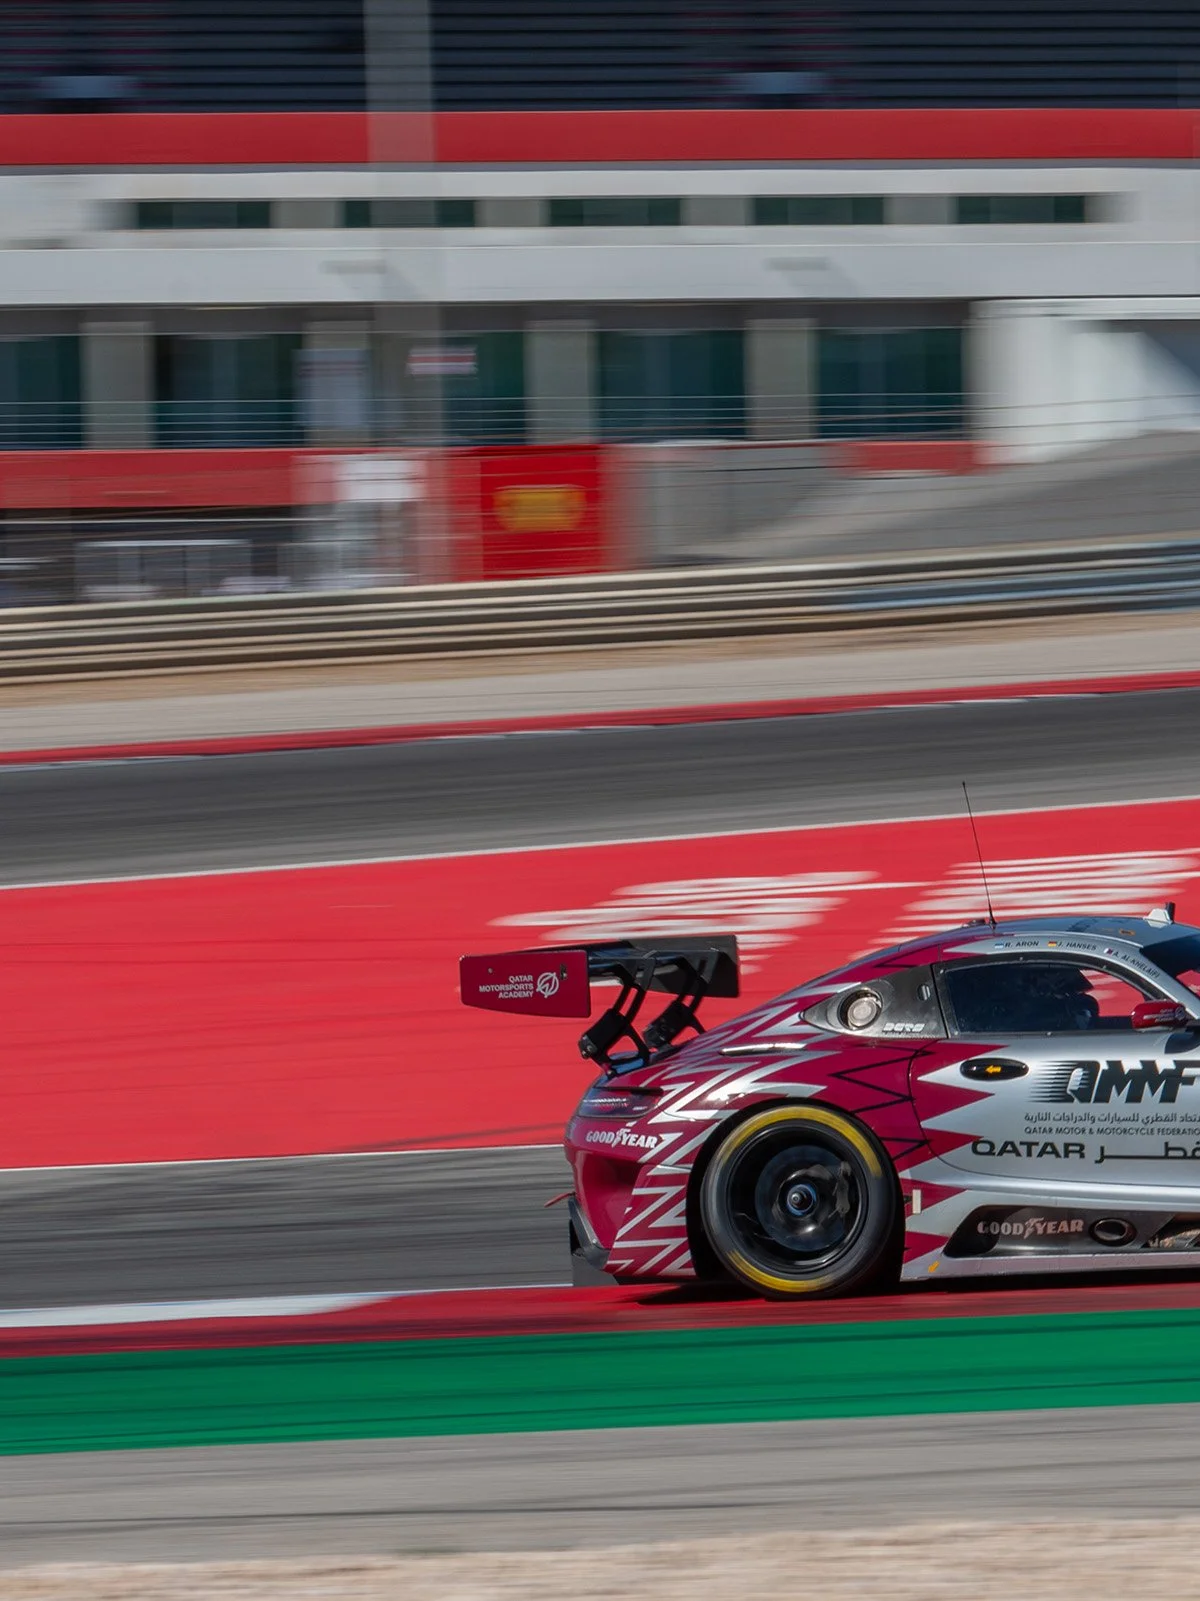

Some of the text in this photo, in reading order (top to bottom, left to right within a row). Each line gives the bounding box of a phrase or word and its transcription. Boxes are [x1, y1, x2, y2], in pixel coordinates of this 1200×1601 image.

[1066, 942, 1097, 951] HANSES
[508, 975, 534, 983] QATAR
[479, 983, 534, 992] MOTORSPORTS
[498, 991, 534, 999] ACADEMY
[586, 1121, 658, 1148] GOODYEAR
[1024, 1127, 1053, 1135] QATAR
[1055, 1127, 1086, 1136] MOTOR
[1088, 1128, 1094, 1136] &
[1096, 1127, 1154, 1136] MOTORCYCLE
[971, 1140, 1086, 1159] QATAR
[977, 1217, 1085, 1239] GOODYEAR
